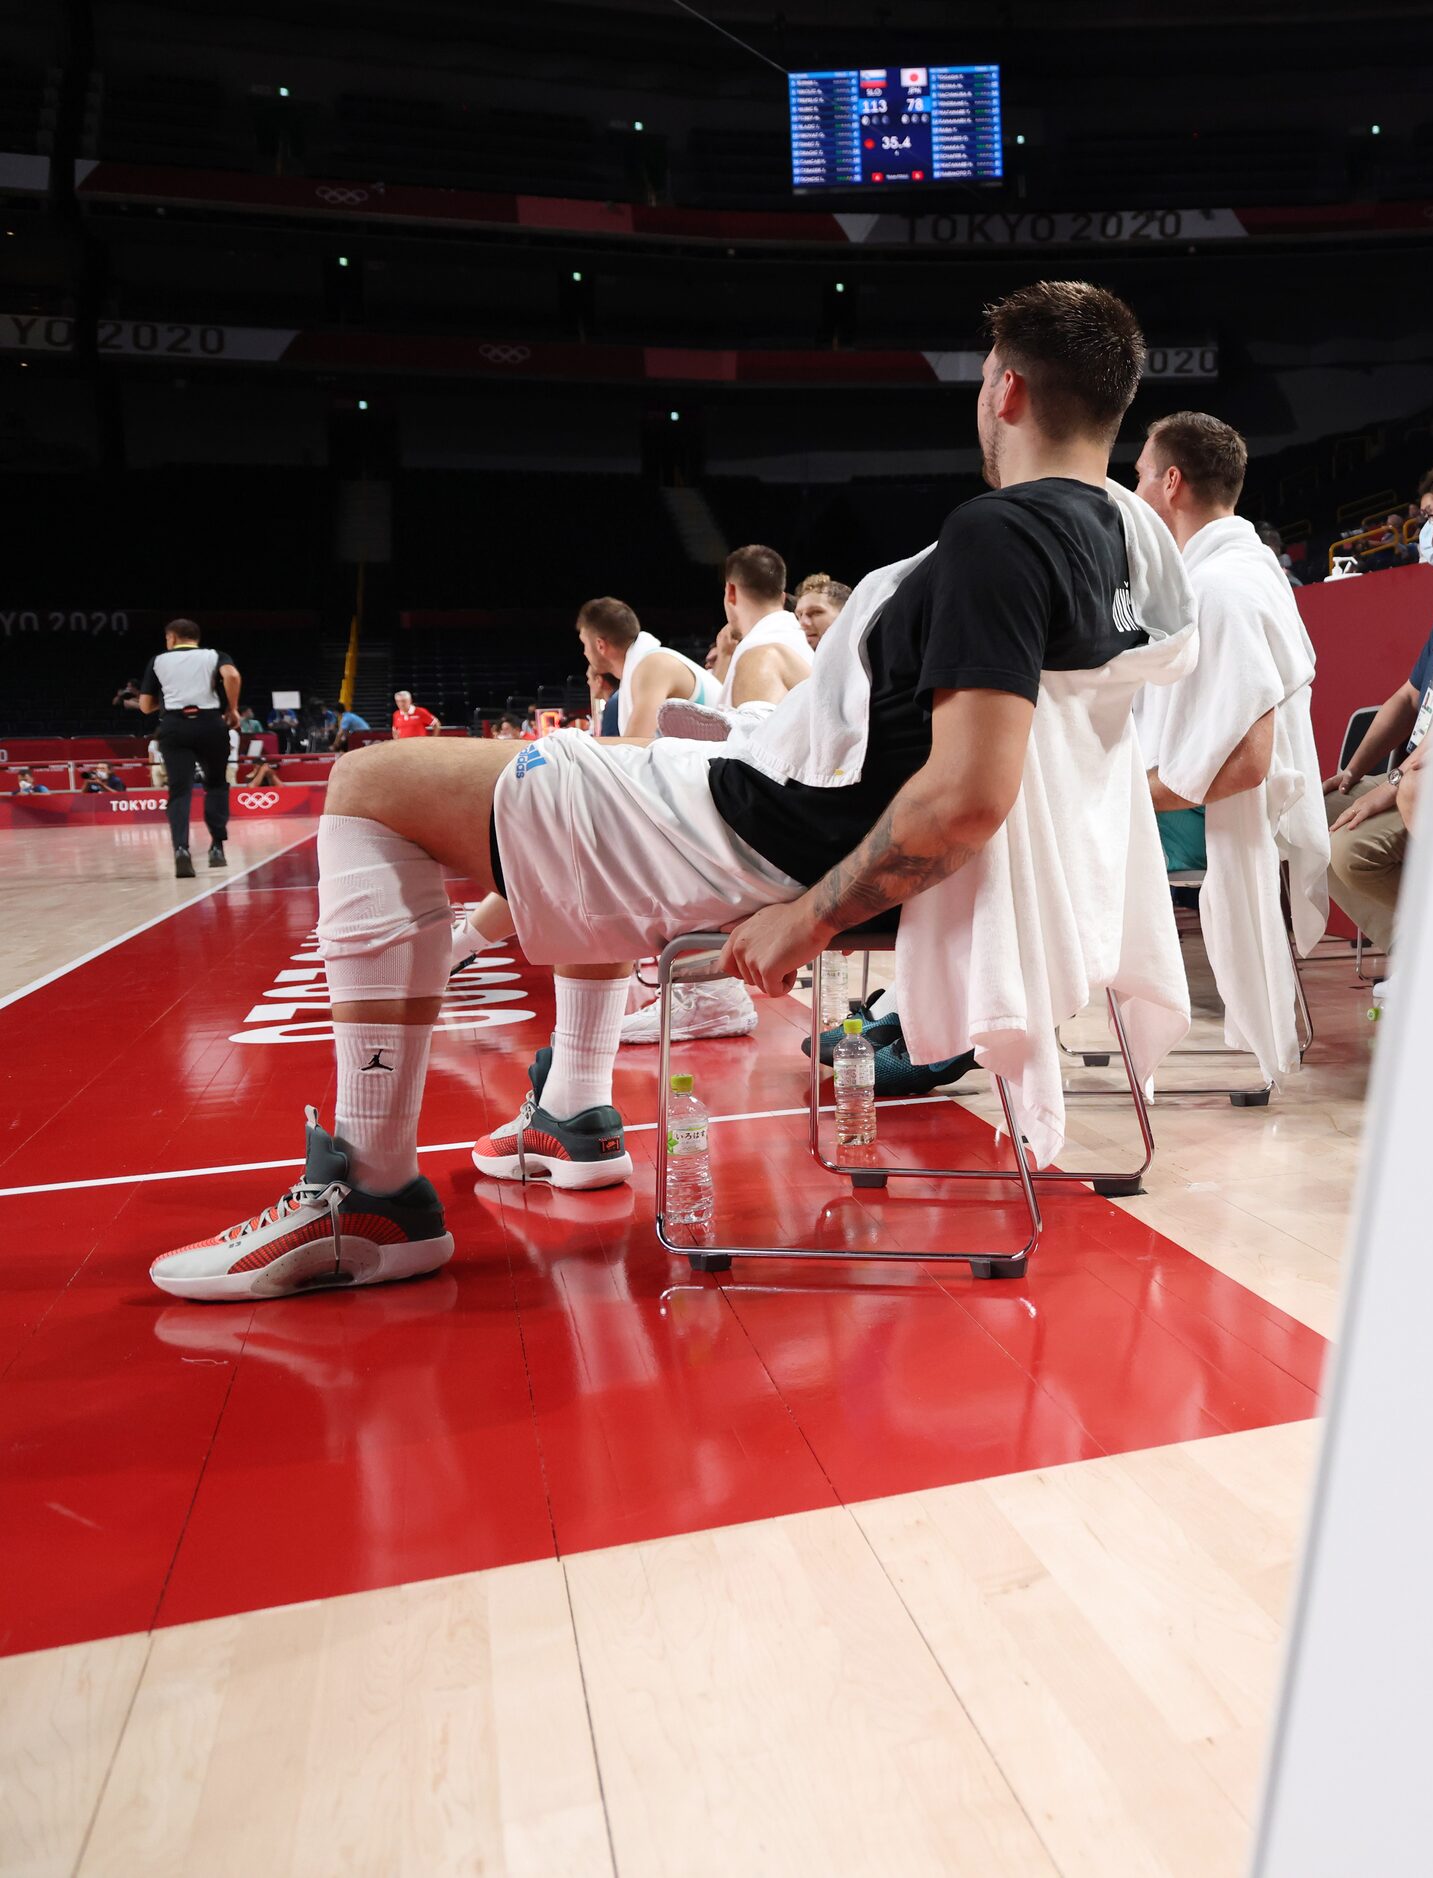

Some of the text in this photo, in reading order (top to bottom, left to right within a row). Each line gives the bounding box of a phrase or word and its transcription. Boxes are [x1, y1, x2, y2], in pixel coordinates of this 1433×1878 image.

[866, 88, 883, 97] SLO
[862, 99, 888, 113] 113
[881, 136, 912, 149] 35.4
[901, 209, 1182, 242] TOKYO 2020
[97, 321, 225, 354] 2020
[1148, 349, 1218, 373] 020
[110, 799, 157, 812] TOKYO
